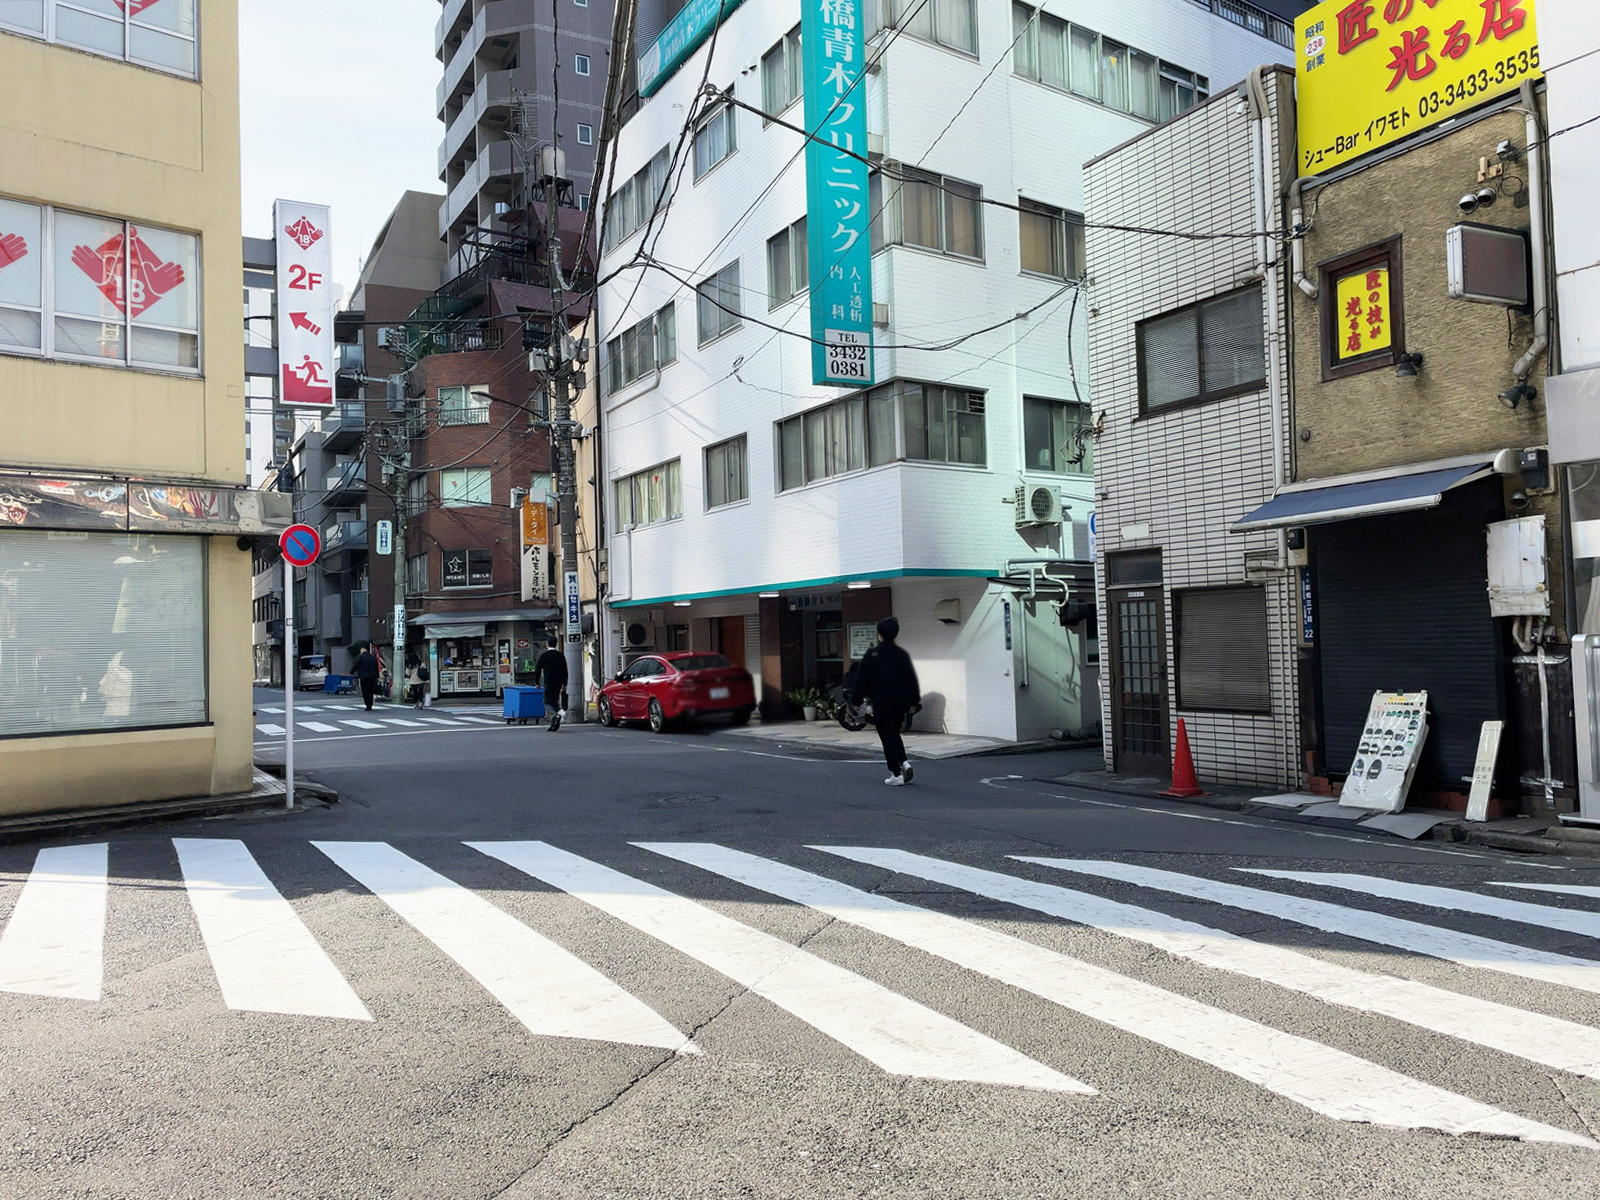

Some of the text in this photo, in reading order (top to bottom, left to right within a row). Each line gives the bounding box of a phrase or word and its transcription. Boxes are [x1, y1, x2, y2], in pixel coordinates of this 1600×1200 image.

[1305, 21, 1325, 39] 昭和
[1335, 0, 1443, 55] 匠の
[1306, 38, 1325, 54] 23年
[1385, 0, 1527, 92] 光る店
[1306, 55, 1325, 73] 創業
[1364, 107, 1411, 142] イワモト
[1418, 45, 1540, 118] 03-3433-3535
[299, 234, 311, 245] 18
[288, 264, 322, 291] 2F
[829, 265, 845, 320] 内科
[849, 266, 863, 323] 人工透析
[1366, 271, 1384, 339] 匠の技が
[1345, 297, 1362, 351] 光る店
[838, 333, 858, 343] TEL
[829, 344, 866, 360] 3432
[831, 361, 866, 377] 0381
[1304, 629, 1314, 639] 22
